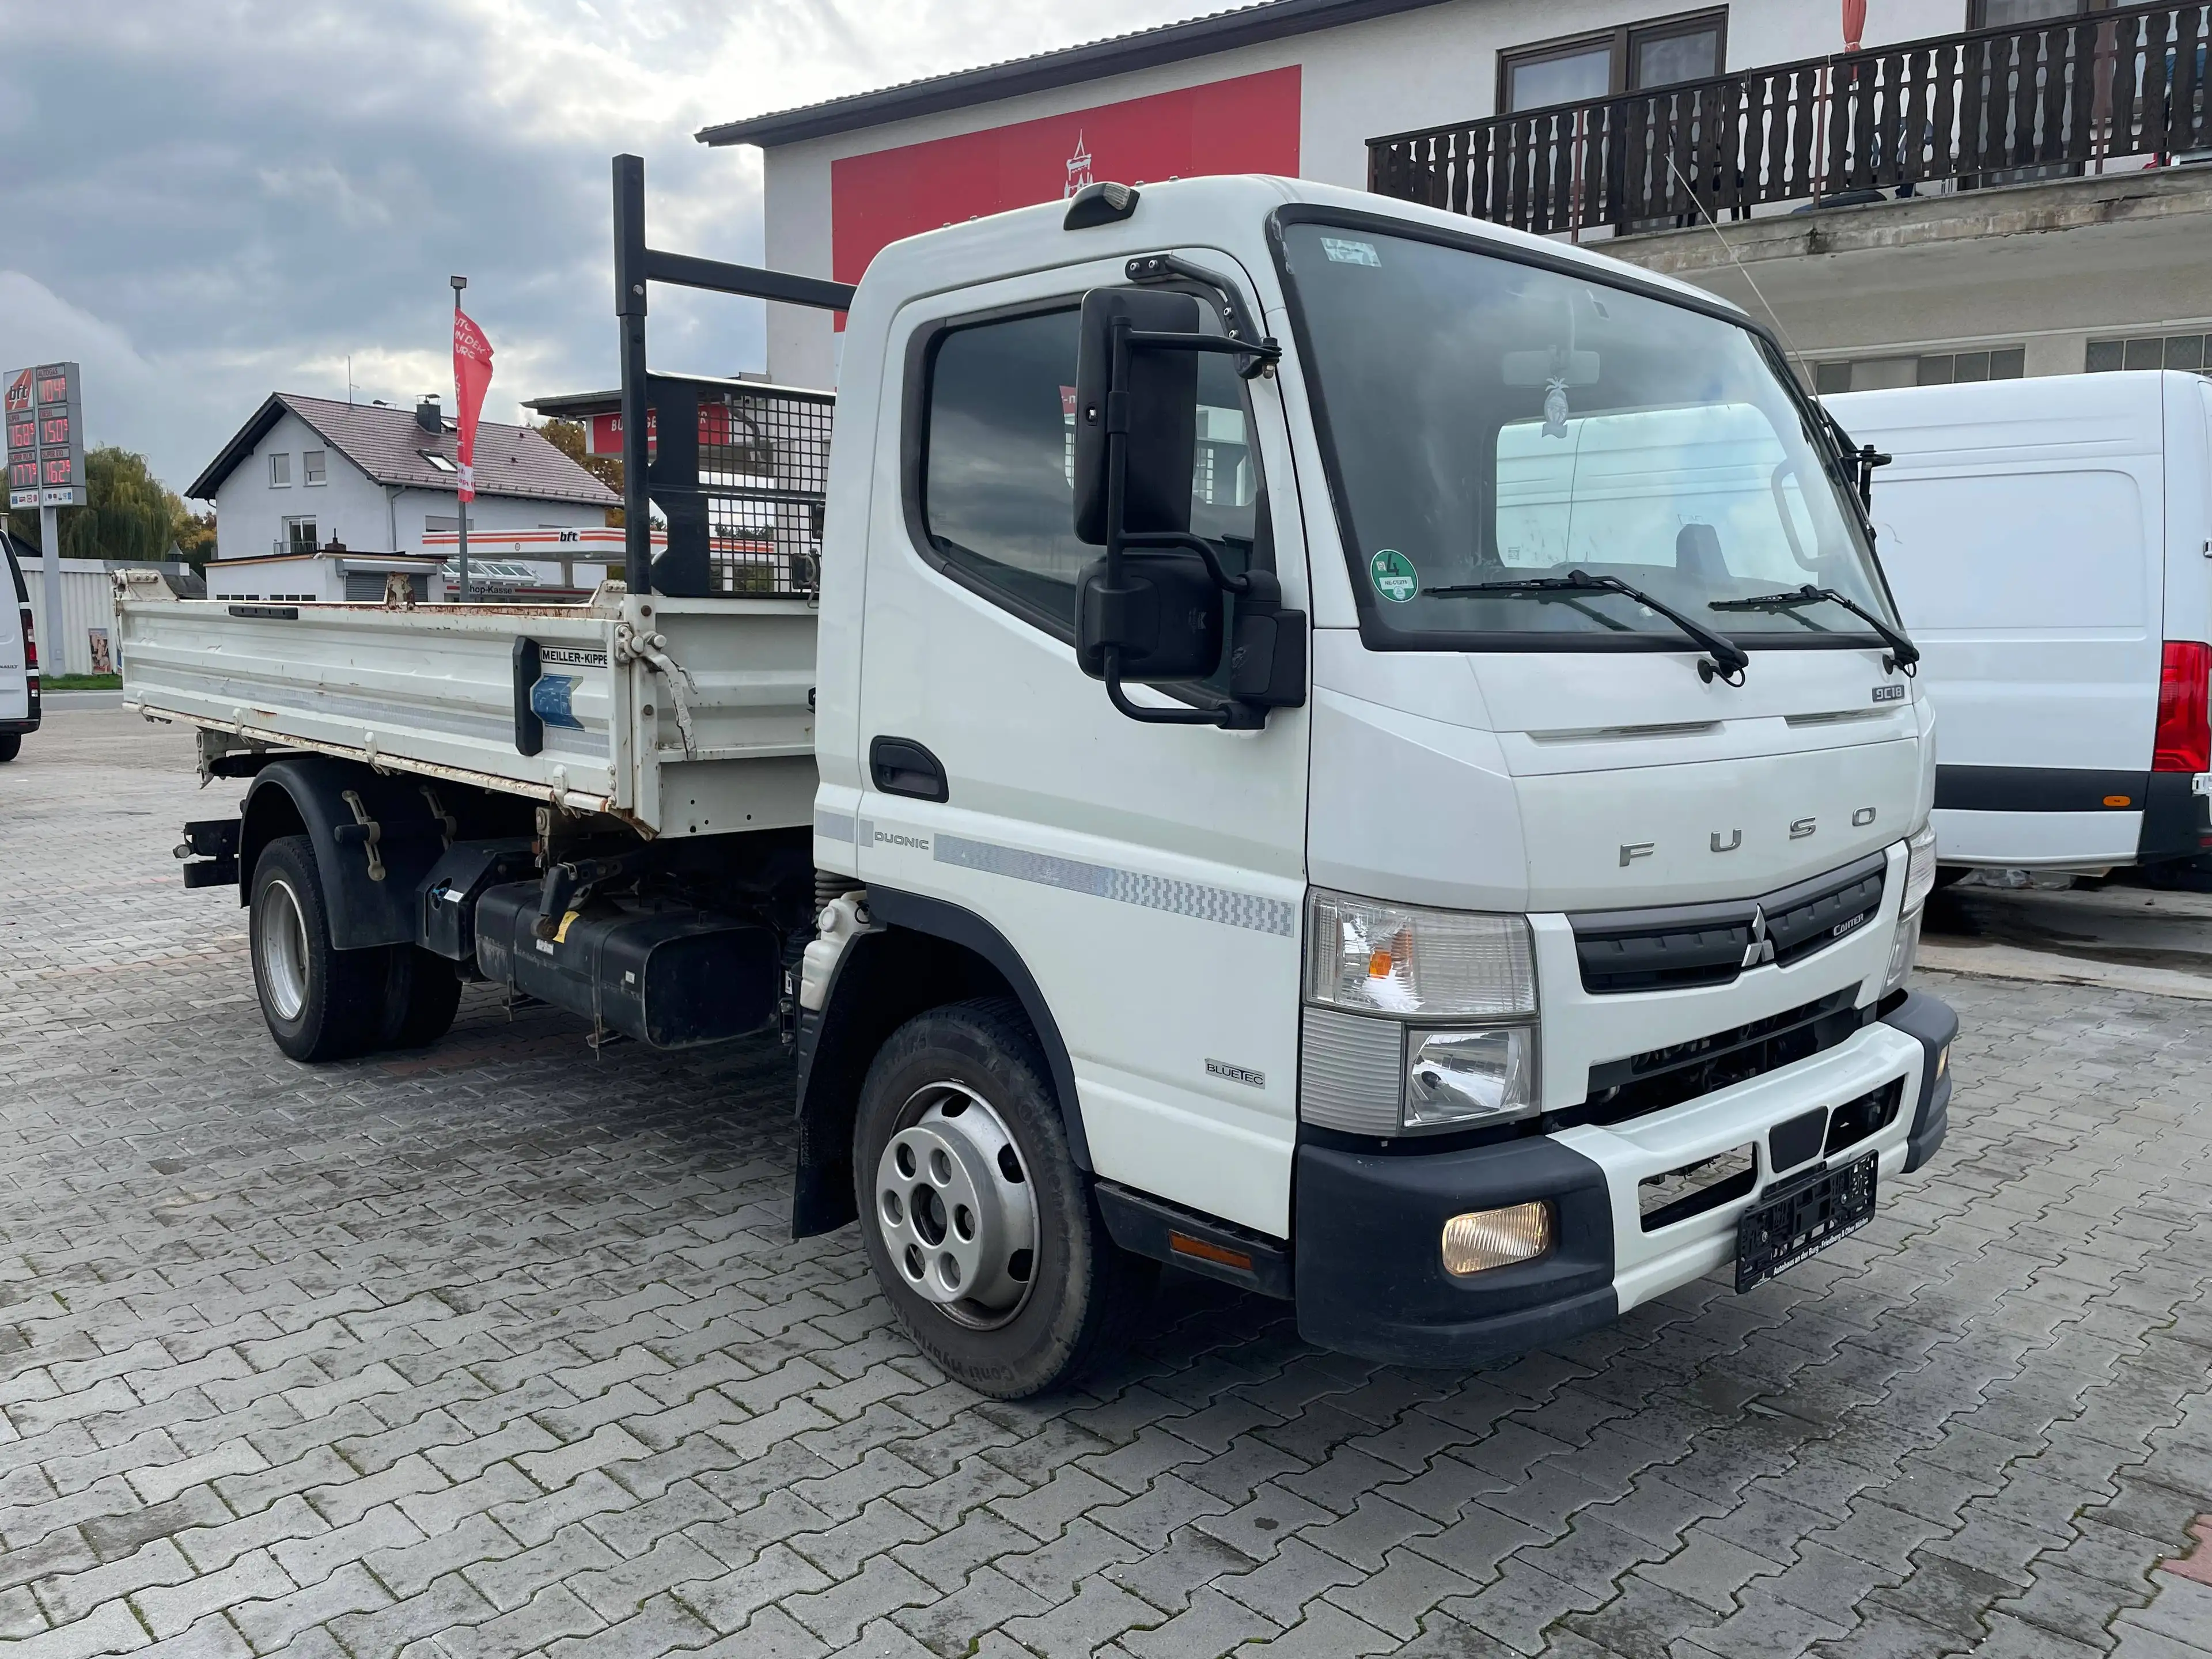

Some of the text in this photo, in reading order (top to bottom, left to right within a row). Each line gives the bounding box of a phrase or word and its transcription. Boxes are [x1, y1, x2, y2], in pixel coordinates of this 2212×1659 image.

[38, 368, 58, 378] AUTOGAS
[9, 384, 28, 402] bft
[559, 531, 578, 542] bft
[1387, 553, 1400, 575] 4
[468, 585, 512, 594] hop-Kasse
[1876, 687, 1902, 700] 9C18
[874, 831, 929, 850] DUONIC
[1619, 806, 1876, 867] FUSO
[1834, 913, 1863, 937] CANTER
[1207, 1063, 1263, 1085] BLUETEC
[1773, 1259, 1794, 1276] Autohaus
[1794, 1255, 1800, 1263] an
[1801, 1251, 1809, 1260] der
[1808, 1245, 1819, 1256] Burg
[1821, 1233, 1842, 1249] Friedberg
